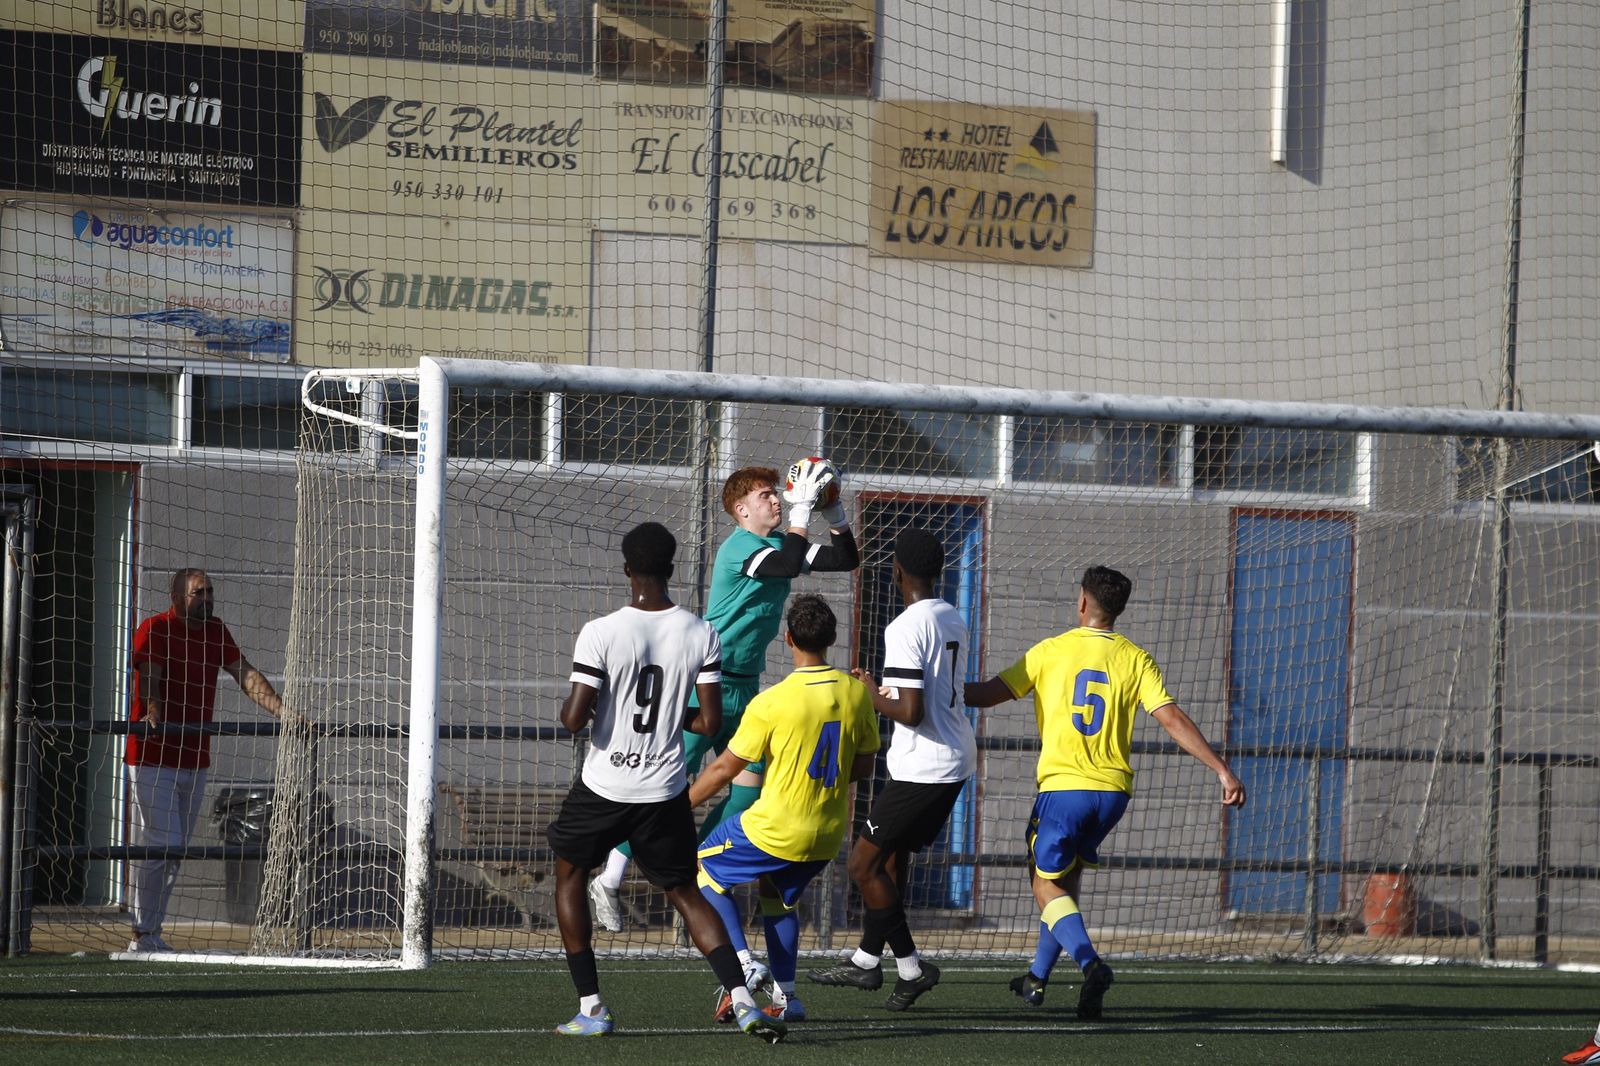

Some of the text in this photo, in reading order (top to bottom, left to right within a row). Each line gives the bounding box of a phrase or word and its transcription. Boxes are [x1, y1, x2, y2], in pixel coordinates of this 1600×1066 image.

[96, 0, 205, 33] Blanes
[319, 29, 341, 45] 950
[346, 31, 367, 46] 290
[373, 33, 394, 49] 913
[77, 55, 223, 127] Guerin
[386, 100, 583, 148] El Plantel
[740, 110, 853, 130] EXCAVACIONES
[961, 123, 1012, 147] HOTEL
[42, 144, 105, 160] DISTRIBUCIÓN
[107, 145, 145, 162] TÉCNICA
[147, 150, 159, 164] DE
[161, 152, 203, 168] MATERIAL
[386, 140, 577, 170] SEMILLEROS
[631, 133, 680, 174] El
[900, 147, 1010, 174] RESTAURANTE
[56, 161, 110, 177] HIDRÁULICO
[121, 166, 177, 182] FONTANERÍA
[189, 169, 240, 186] SANITARIOS
[393, 180, 504, 203] 950 330 101
[648, 197, 693, 214] 606
[772, 203, 816, 220] 368
[886, 185, 1076, 252] LOS ARCOS
[106, 222, 234, 250] aguaconfort
[193, 263, 265, 278] FONTANERÍA
[2, 285, 55, 300] PISCINAS
[327, 340, 351, 355] 950
[359, 342, 381, 357] 223
[418, 422, 428, 475] MONDO
[945, 640, 960, 709] 7
[633, 665, 664, 734] 9
[1072, 669, 1110, 737] 5
[807, 720, 841, 788] 4
